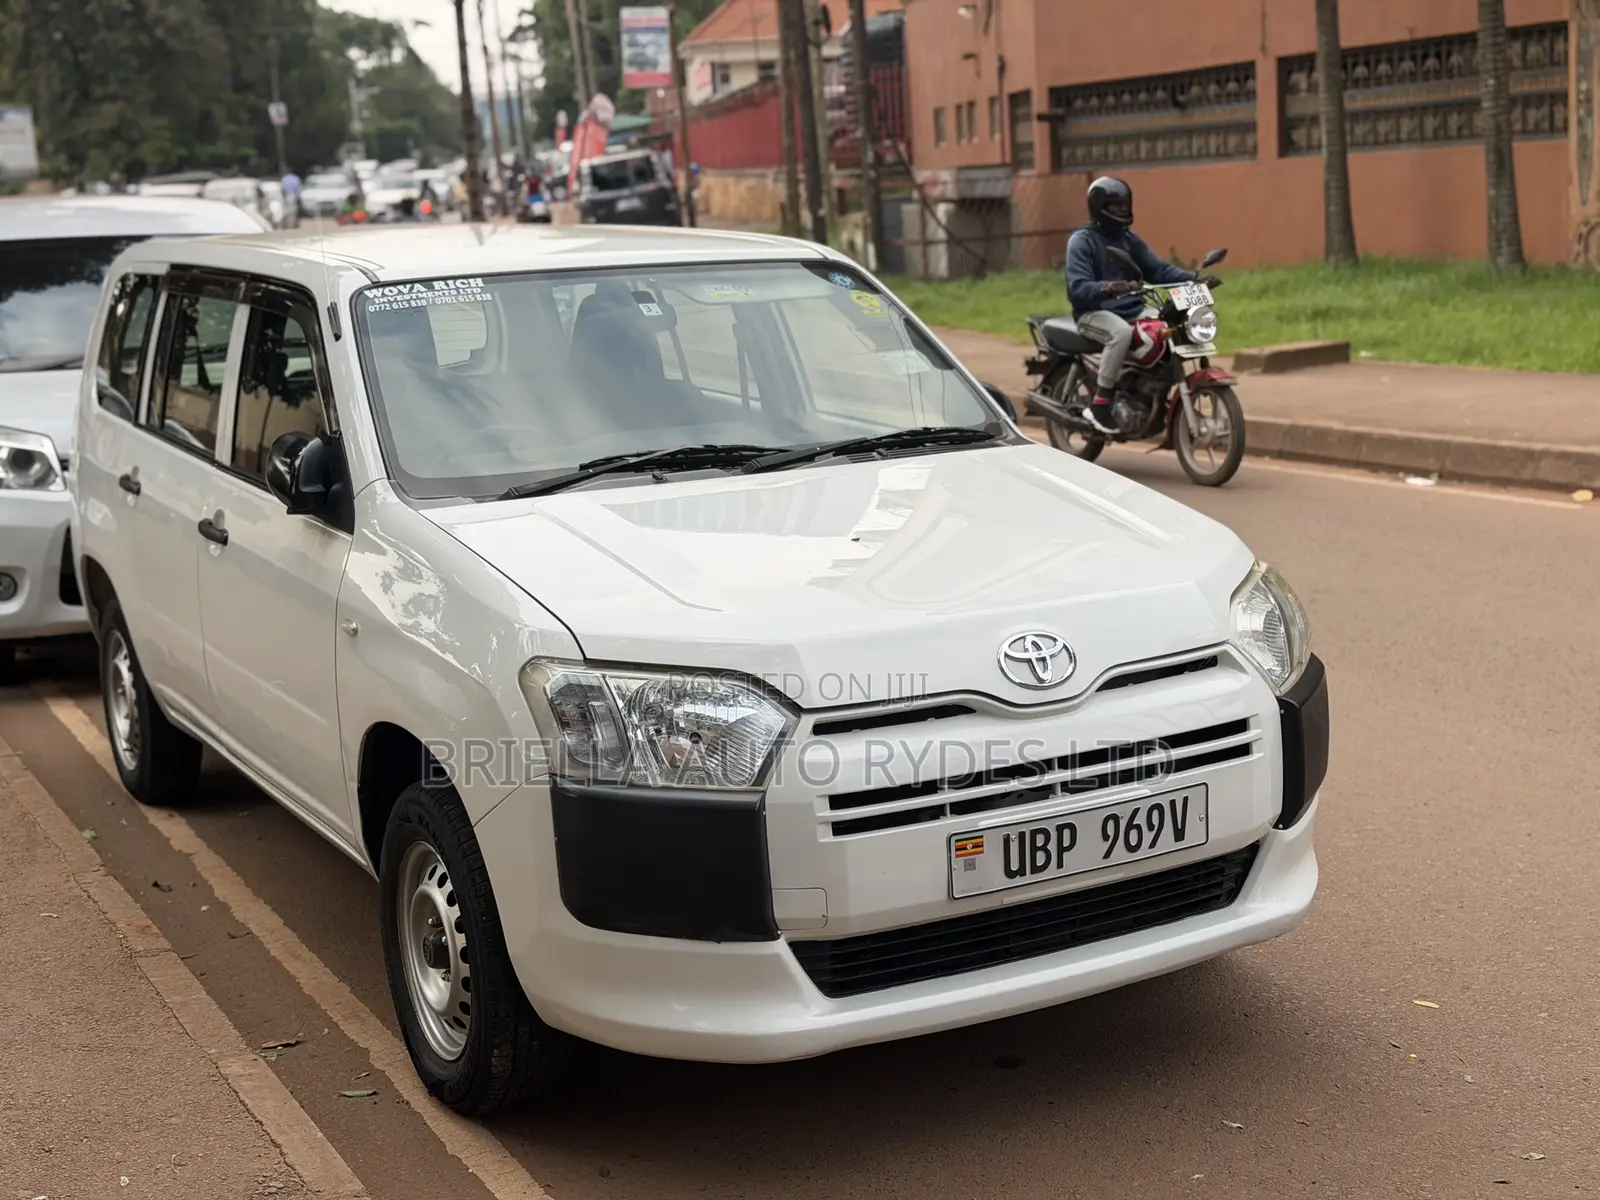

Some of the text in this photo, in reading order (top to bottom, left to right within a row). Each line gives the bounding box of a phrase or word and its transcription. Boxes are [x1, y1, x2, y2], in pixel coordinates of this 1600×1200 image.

[363, 278, 485, 299] WOVA RICH
[374, 287, 481, 304] INVESTMENTS LTD
[368, 303, 391, 313] 0772
[393, 301, 409, 310] 615
[411, 299, 427, 308] 838
[435, 296, 456, 305] 0701
[457, 294, 475, 303] 615
[476, 293, 493, 302] 838
[1003, 795, 1189, 879] UBP 969V
